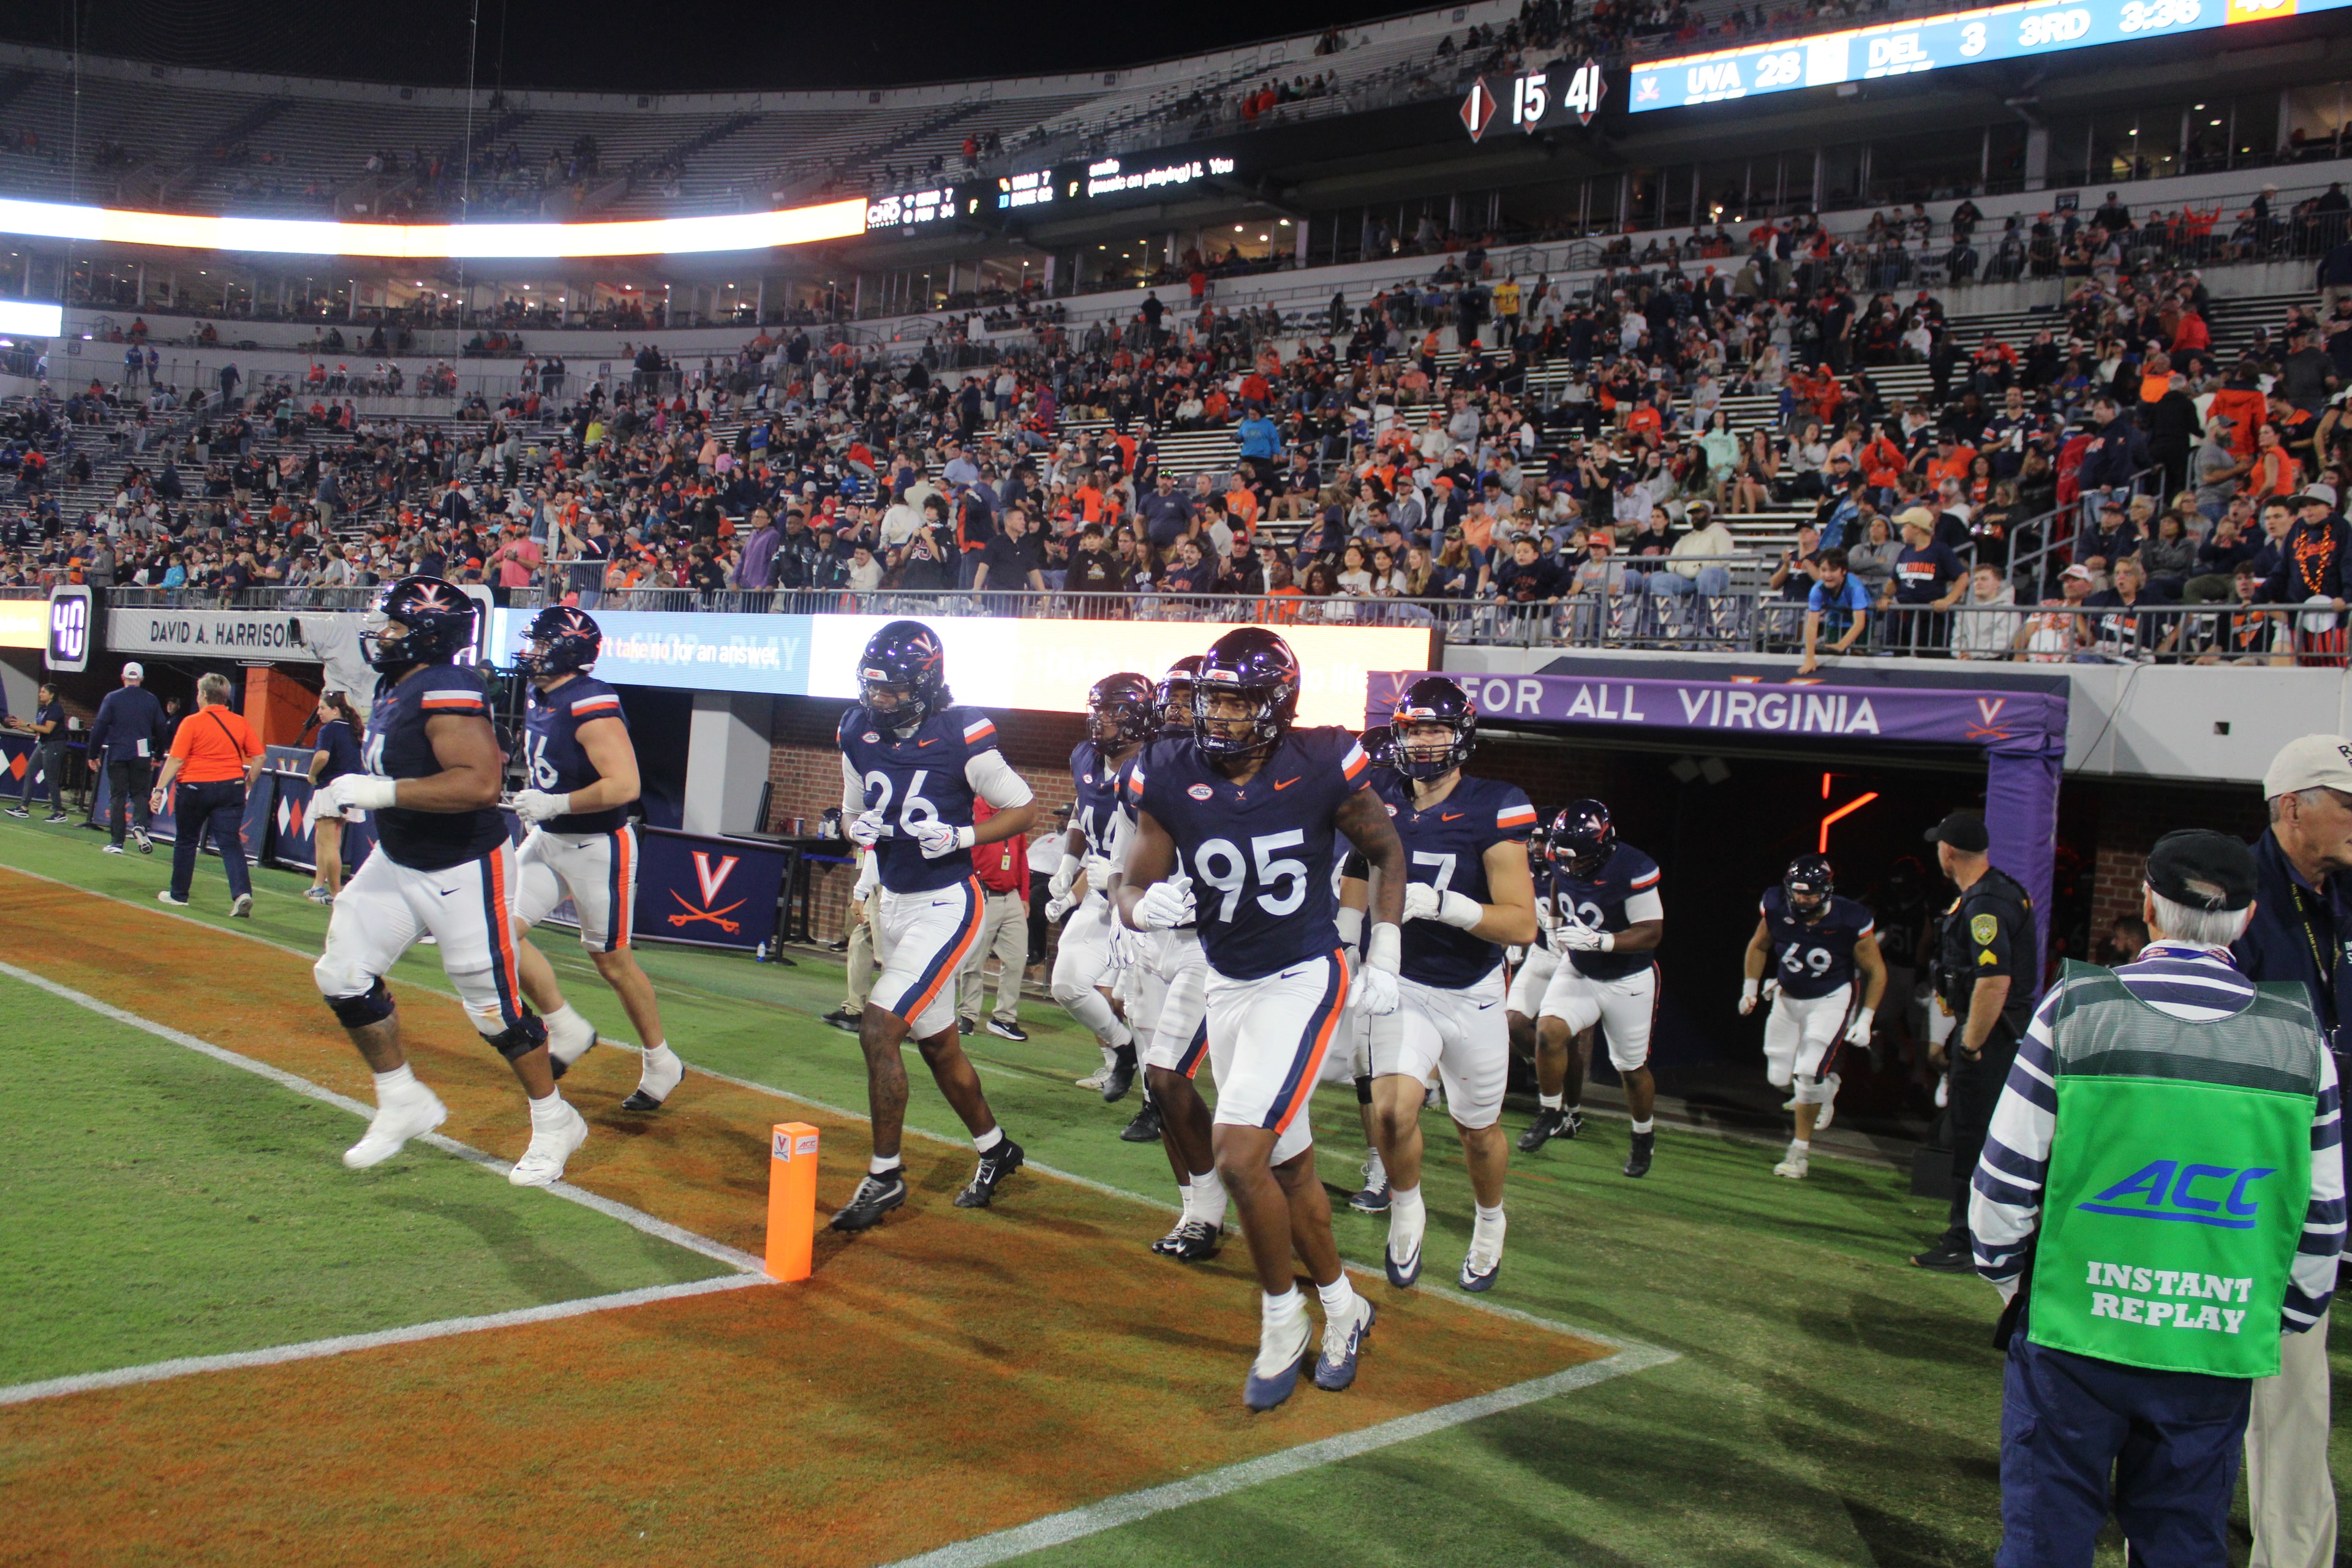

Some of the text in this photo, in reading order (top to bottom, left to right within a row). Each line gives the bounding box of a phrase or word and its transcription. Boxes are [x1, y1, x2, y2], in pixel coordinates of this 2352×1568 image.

[1869, 33, 1928, 68] DEL
[1959, 22, 1986, 56] 3
[2018, 9, 2090, 47] 3RD
[1687, 51, 1801, 94] UVA 28
[1513, 74, 1547, 125] 15
[1564, 65, 1600, 114] 41
[1042, 171, 1052, 186] 7
[1209, 157, 1234, 175] You
[944, 187, 954, 203] 7
[969, 198, 979, 214] F
[1069, 181, 1080, 198] F
[867, 202, 902, 224] CHO
[54, 600, 85, 656] 40
[151, 620, 190, 644] DAVID
[196, 622, 209, 644] A.
[616, 638, 648, 659] take
[650, 640, 669, 660] no
[673, 638, 696, 662] for
[697, 644, 717, 663] an
[719, 644, 780, 666] answer.
[1461, 677, 1881, 735] FOR ALL VIRGINIA
[863, 769, 940, 839] 26
[1191, 787, 1210, 796] ACC
[1194, 828, 1309, 924] 95
[1781, 942, 1832, 978] 69
[797, 1140, 817, 1149] ACC
[2092, 1159, 2278, 1215] ACC
[2086, 1261, 2253, 1303] INSTANT
[2090, 1291, 2246, 1334] REPLAY
